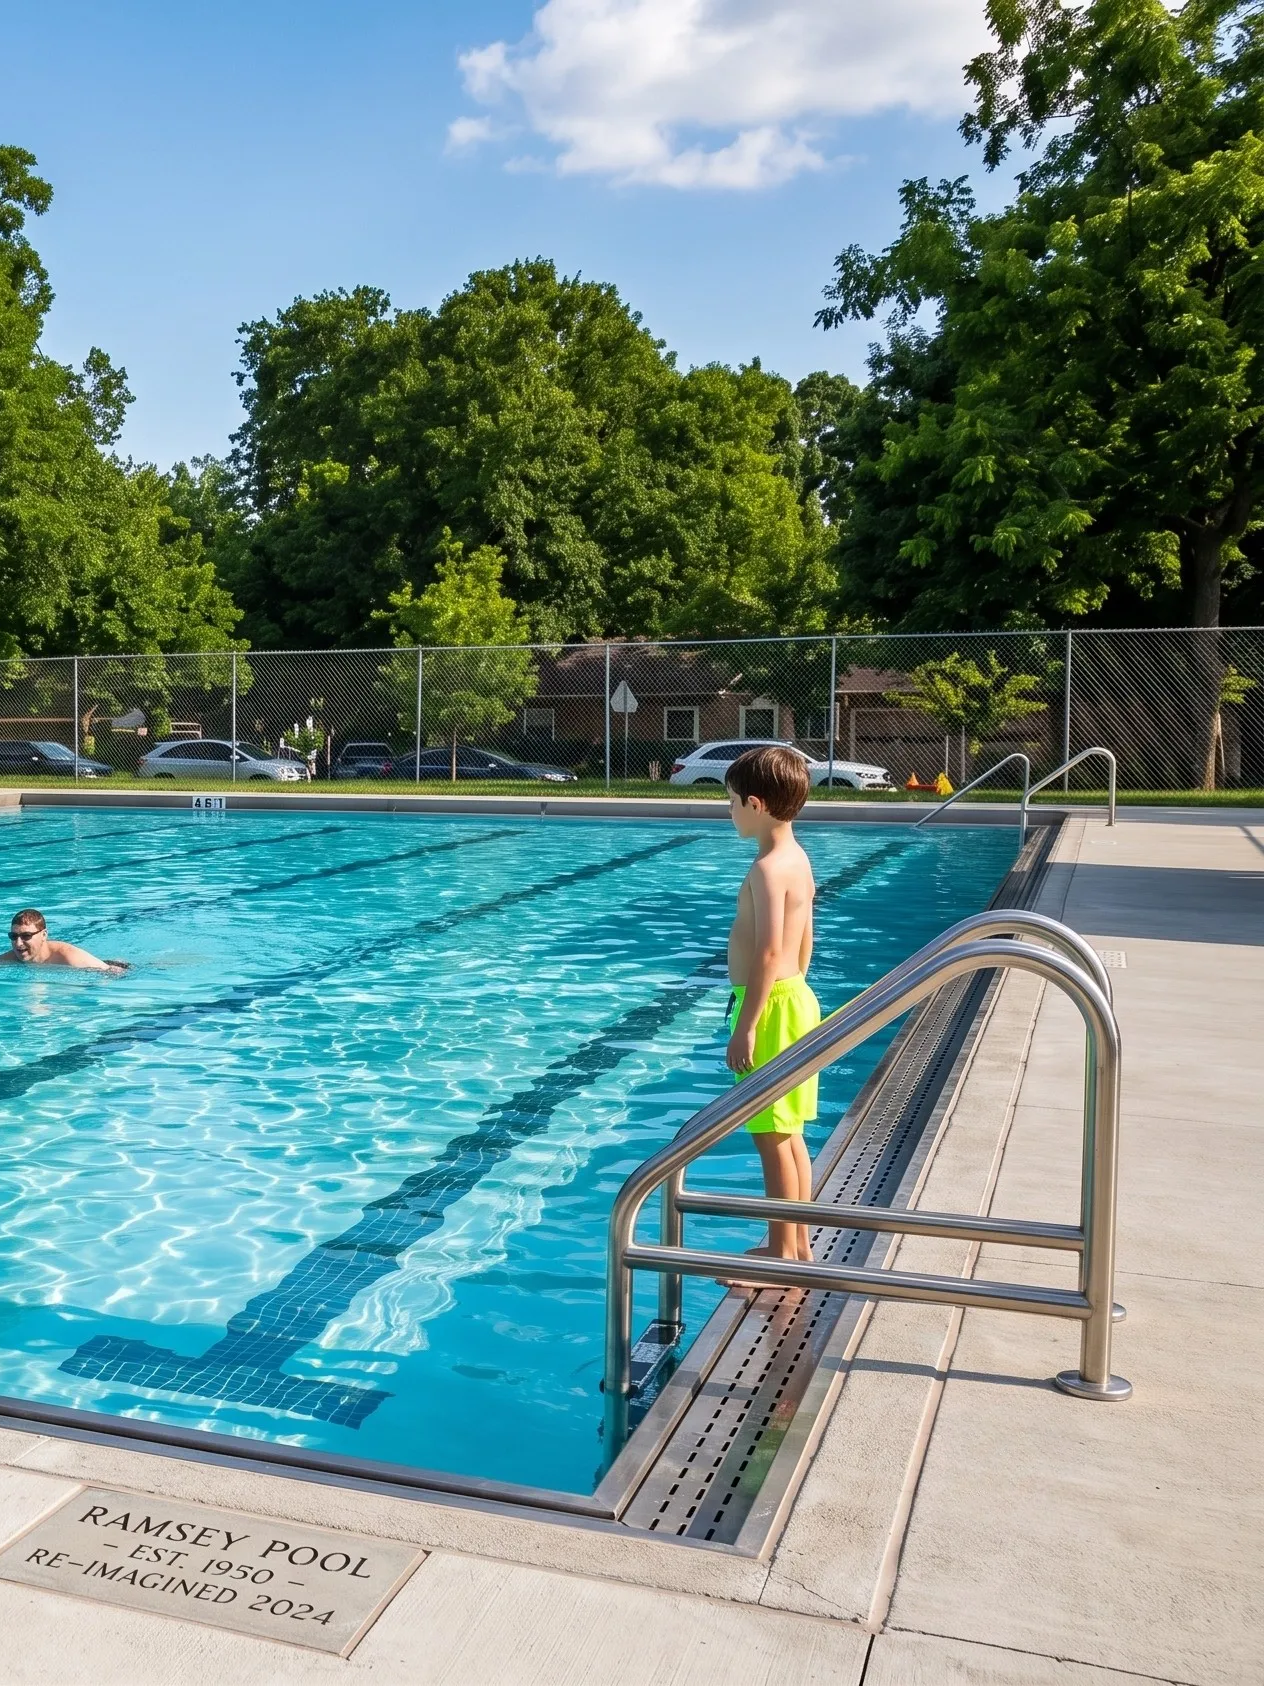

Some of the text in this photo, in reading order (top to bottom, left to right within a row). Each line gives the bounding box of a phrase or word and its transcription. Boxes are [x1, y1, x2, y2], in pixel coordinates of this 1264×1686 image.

[78, 1506, 371, 1578] RAMSEY POOL
[128, 1545, 189, 1568] EST.
[201, 1560, 274, 1584] 1950
[24, 1549, 335, 1625] RE-IMAGINED 2024
